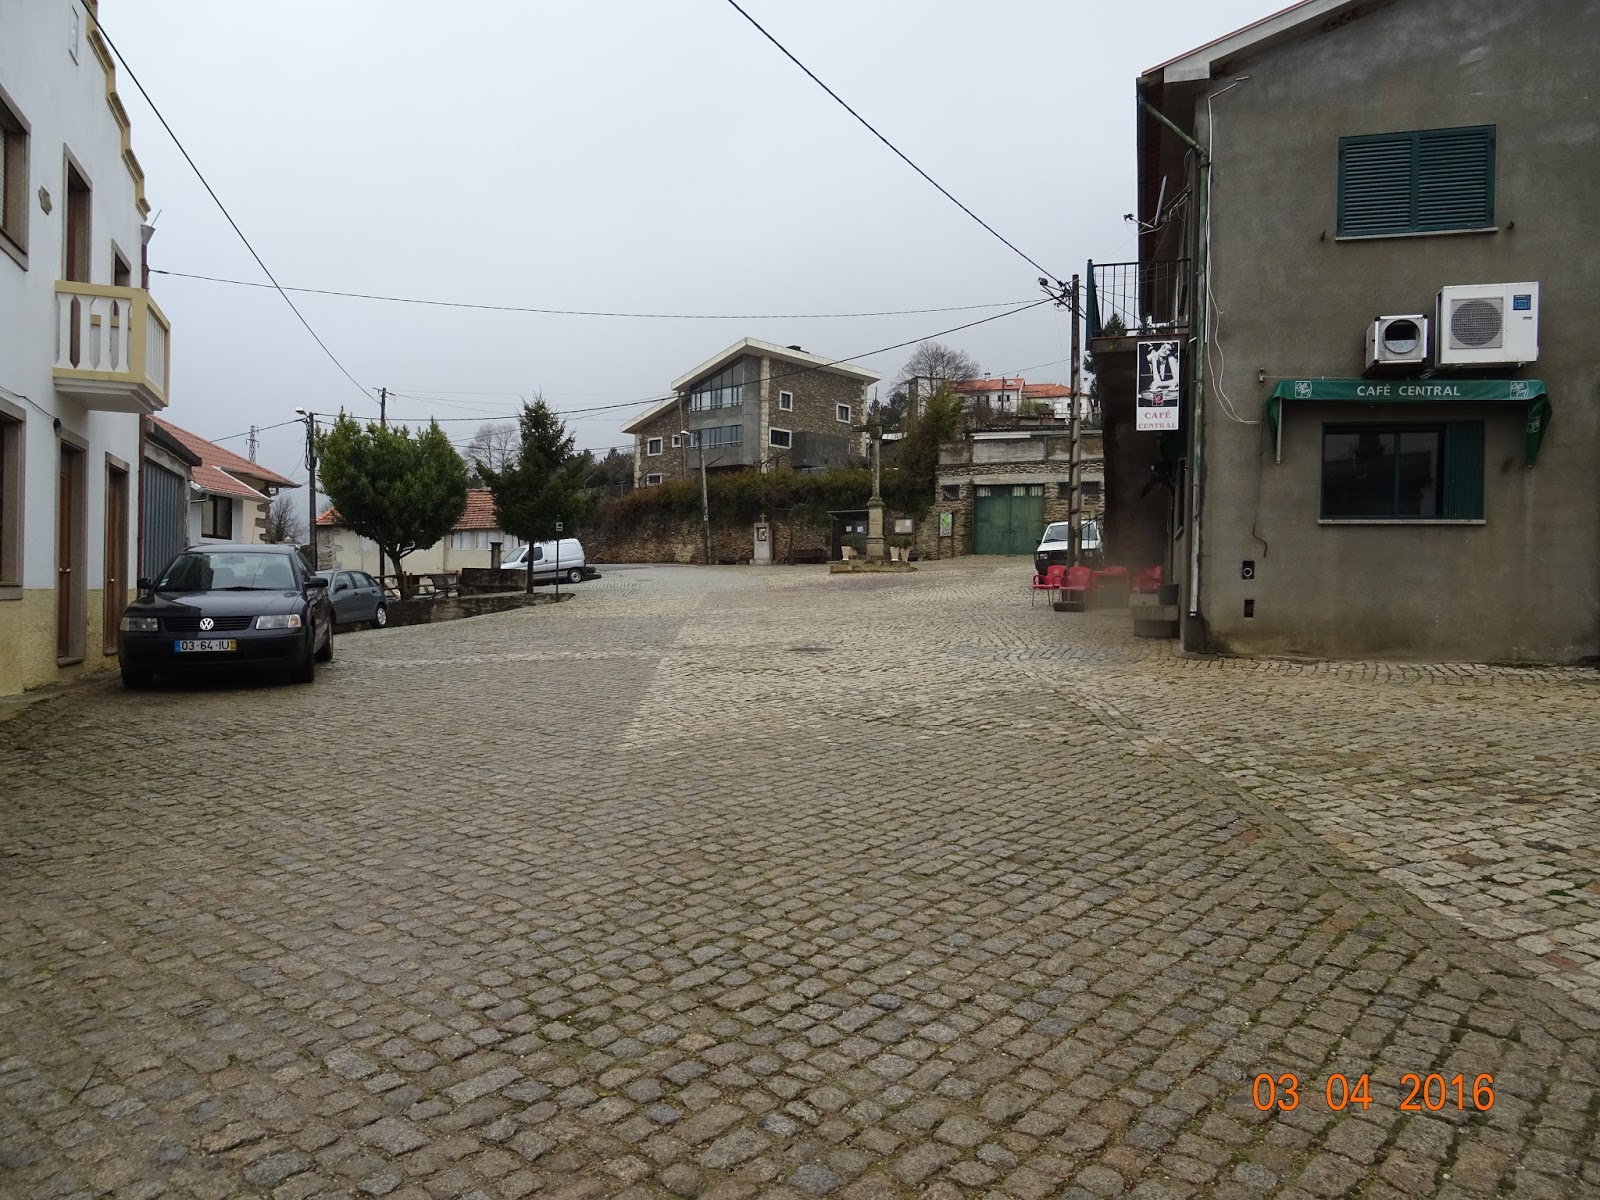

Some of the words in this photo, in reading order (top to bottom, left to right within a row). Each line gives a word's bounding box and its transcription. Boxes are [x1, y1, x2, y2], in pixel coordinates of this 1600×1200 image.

[1357, 384, 1391, 396] CAFÉ
[1398, 386, 1461, 396] CENTRAL
[1144, 410, 1171, 419] CAFÉ
[1138, 422, 1177, 430] CENTRAL
